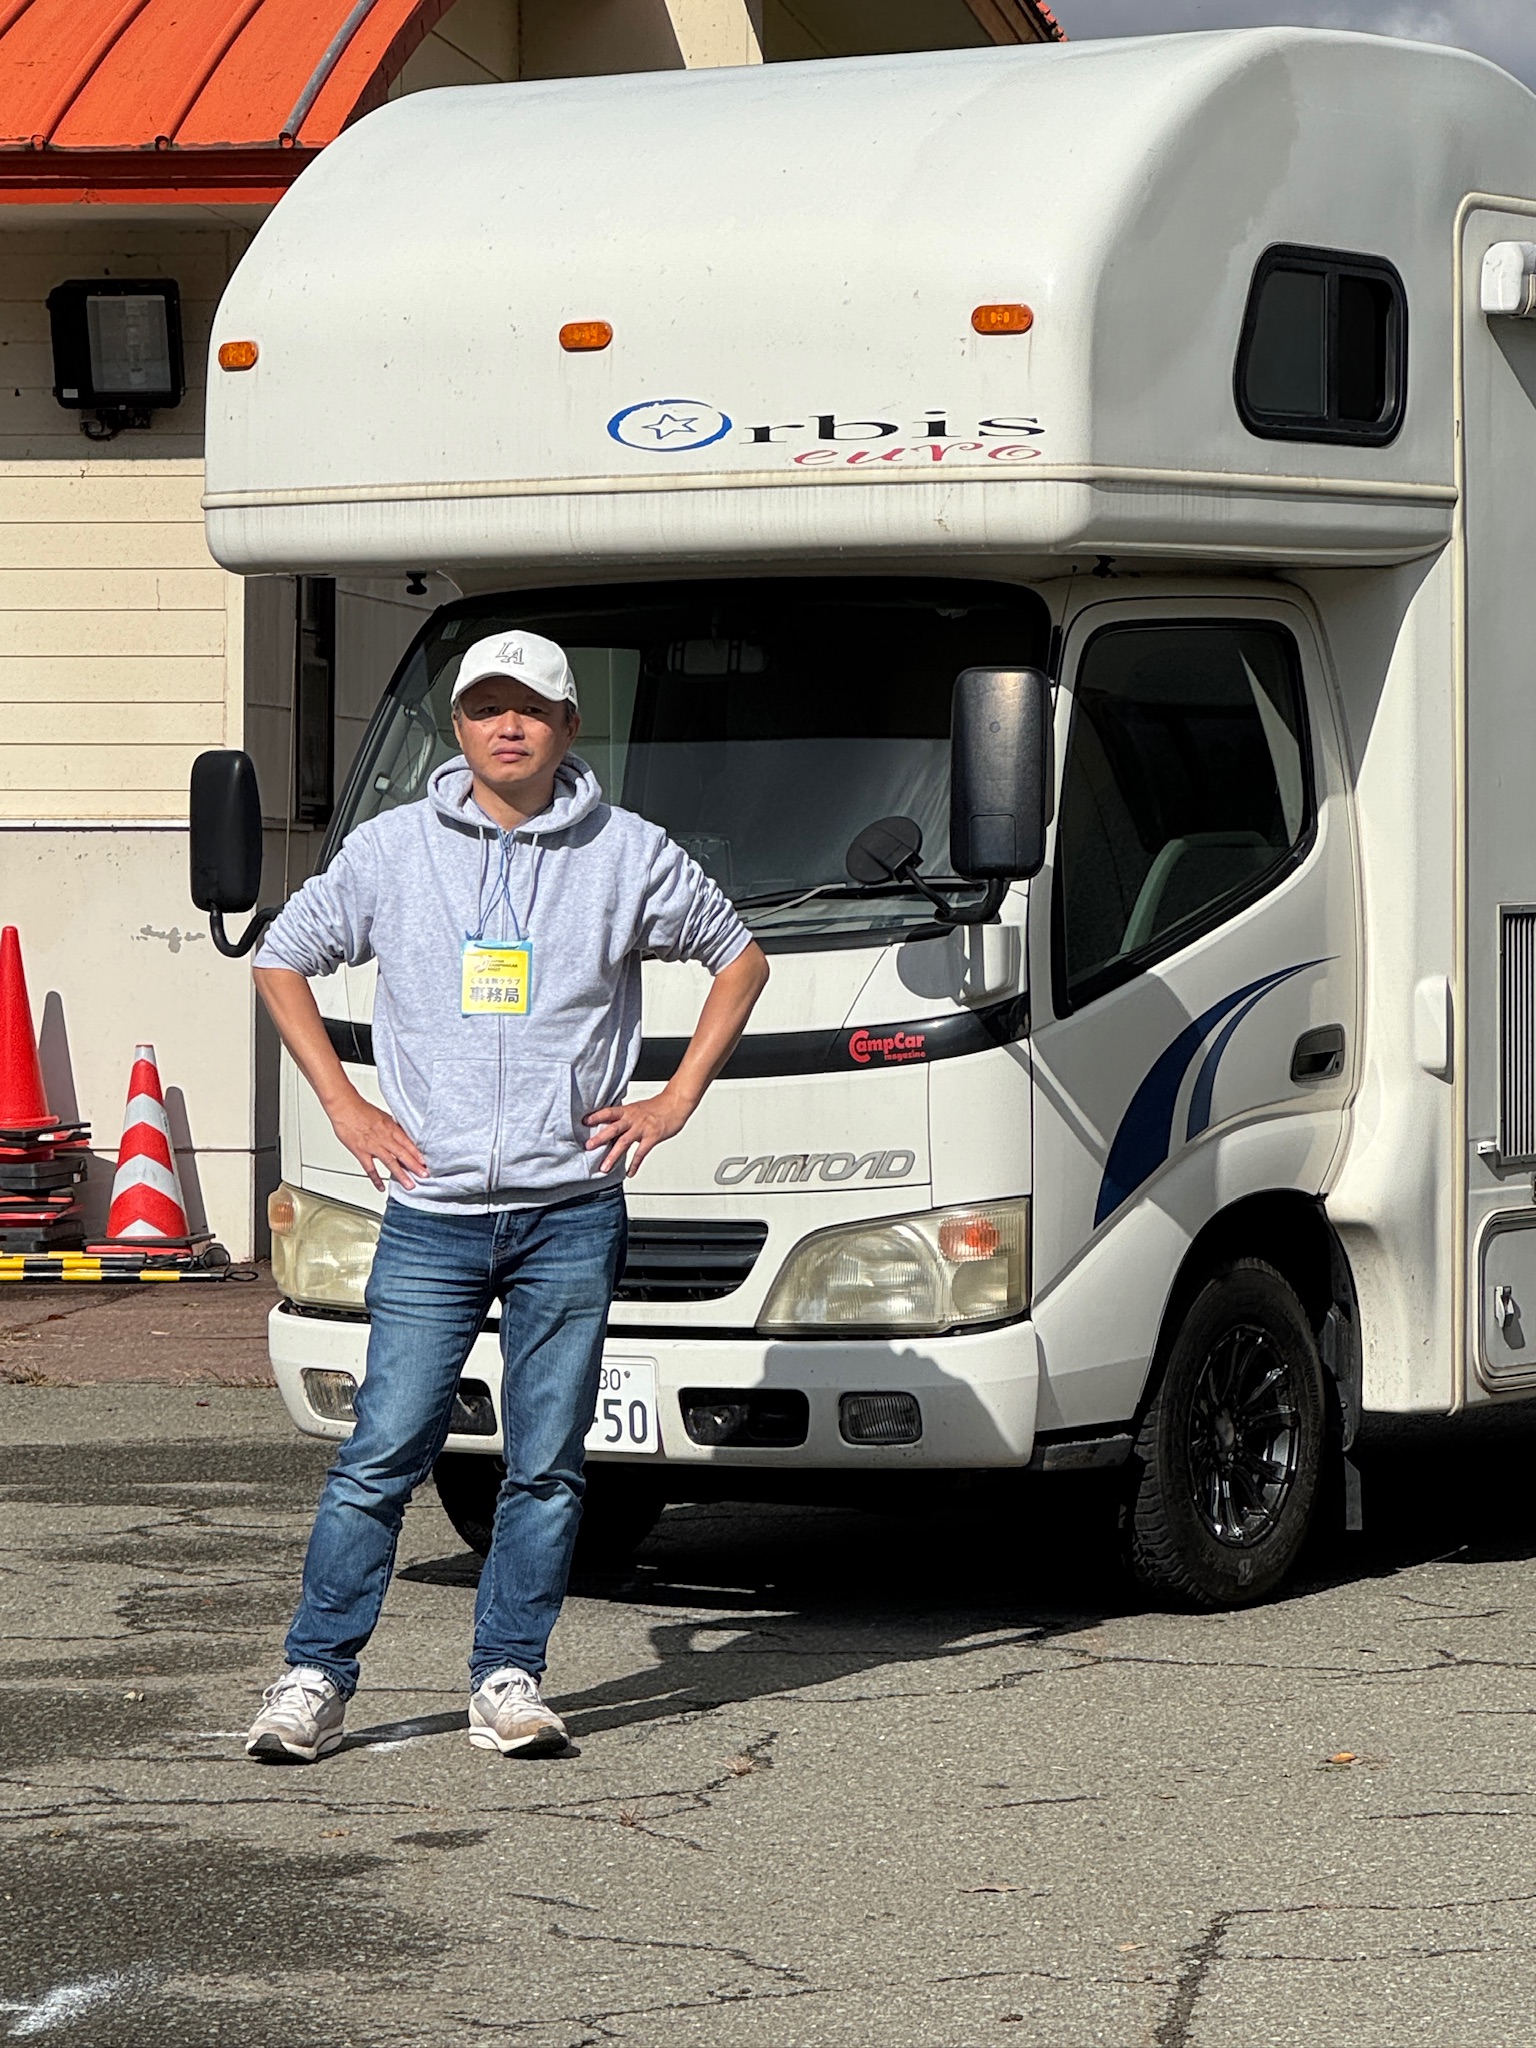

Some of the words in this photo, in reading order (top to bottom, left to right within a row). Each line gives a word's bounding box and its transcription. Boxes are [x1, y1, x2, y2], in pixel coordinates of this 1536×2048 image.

[607, 399, 1045, 452] Orbis
[794, 442, 1042, 465] euro
[495, 641, 525, 665] LA
[469, 986, 520, 1004] 事務局
[848, 1029, 925, 1063] CampCar
[884, 1049, 927, 1062] magazine
